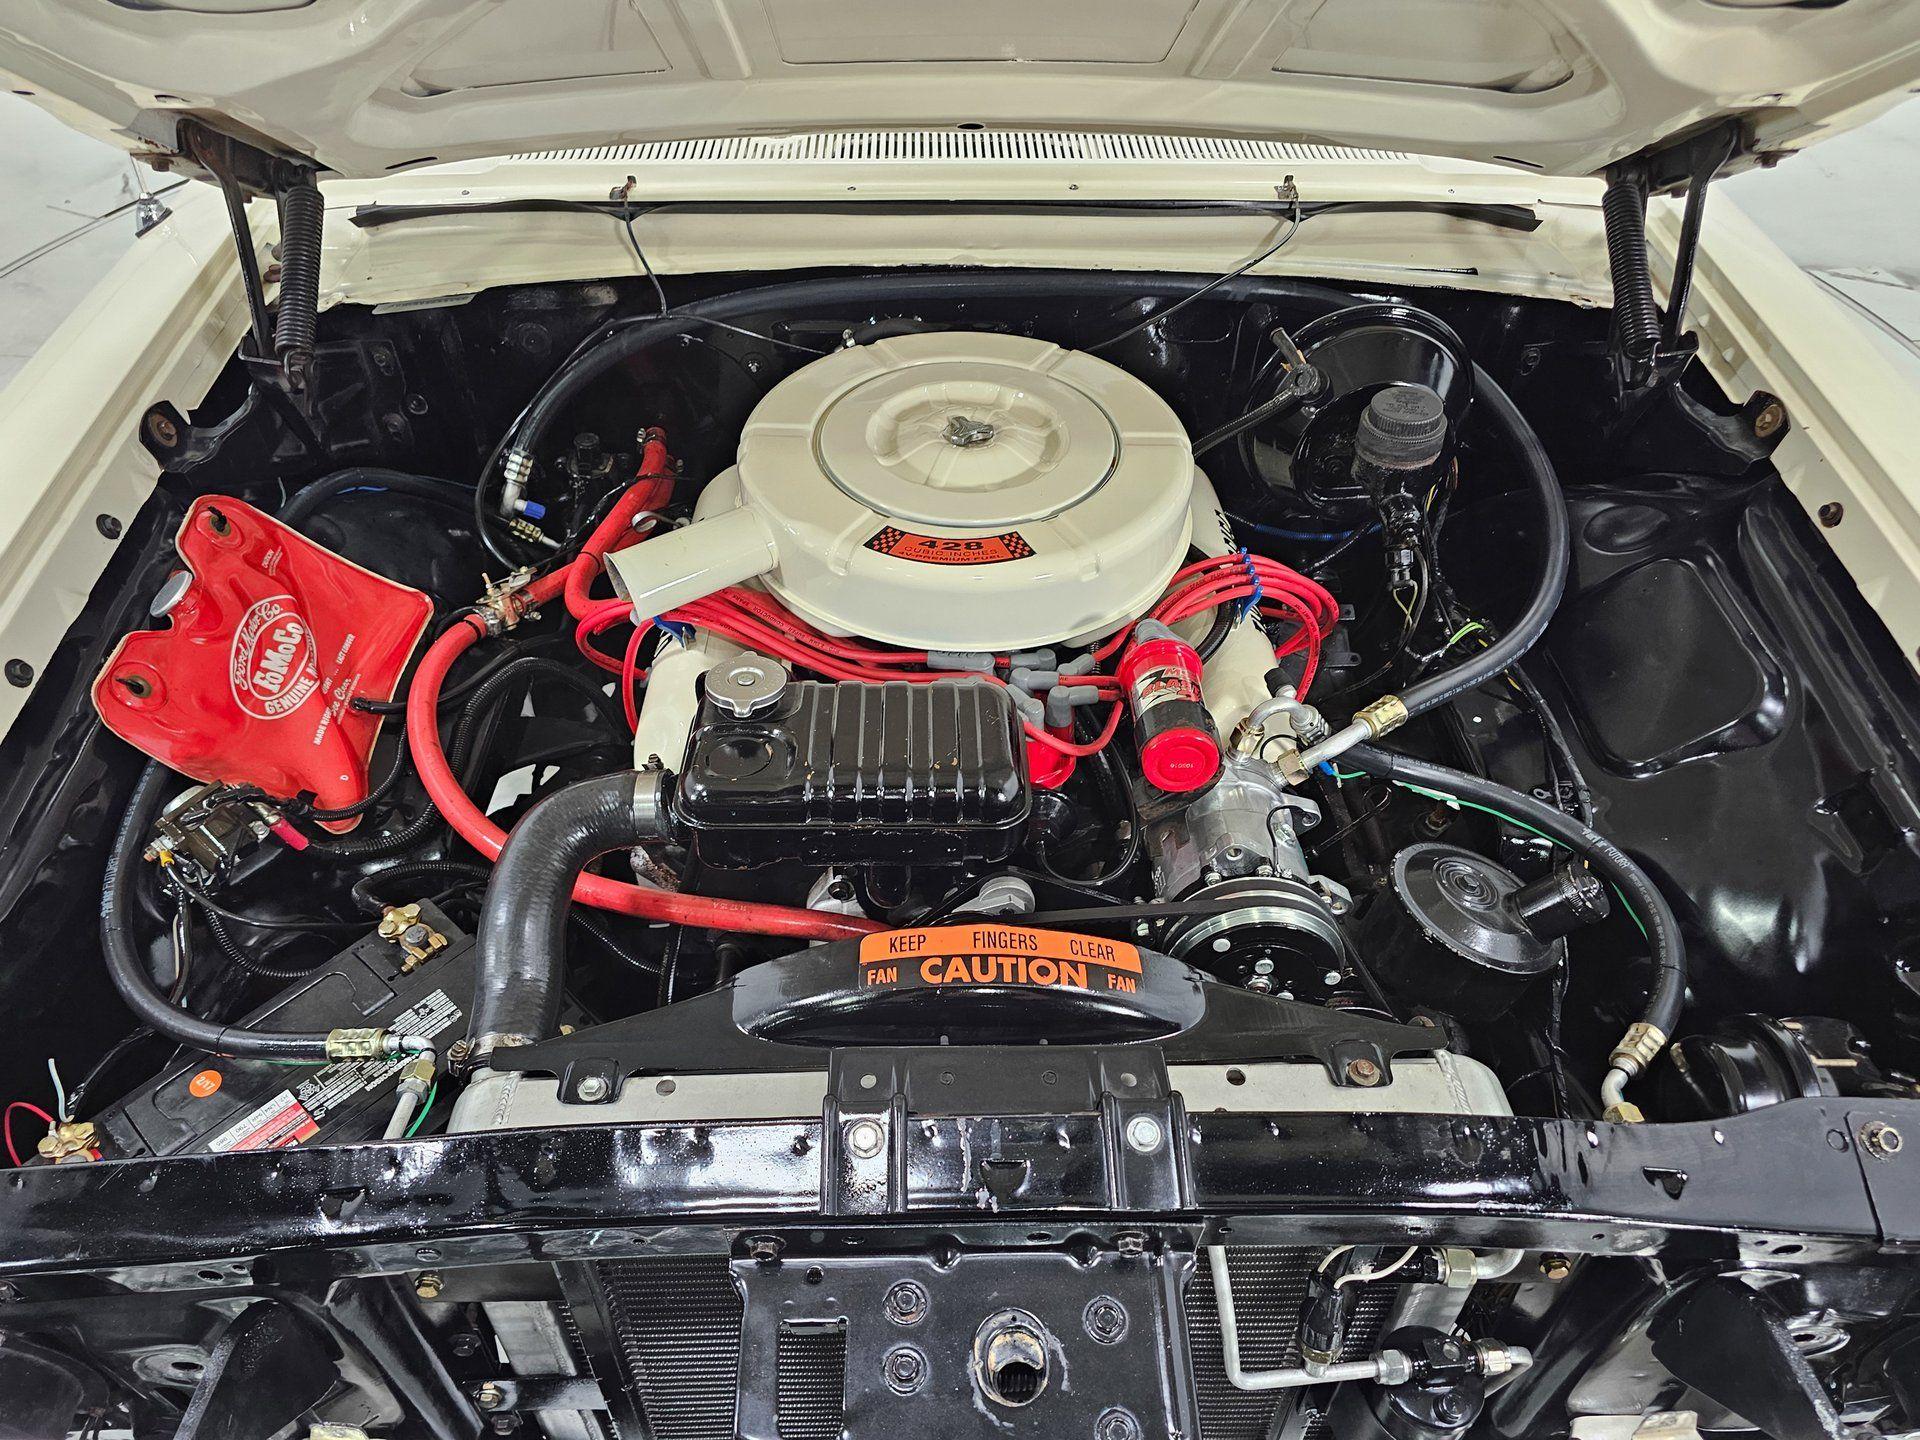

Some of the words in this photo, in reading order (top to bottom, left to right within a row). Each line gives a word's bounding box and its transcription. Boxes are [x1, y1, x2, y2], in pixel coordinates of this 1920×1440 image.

[904, 546, 943, 556] CUBIC
[949, 549, 998, 557] INCHES
[918, 540, 984, 551] 428
[252, 622, 304, 693] FoMoCo
[264, 676, 315, 715] GENUINE
[313, 725, 327, 746] MADE
[889, 934, 927, 953] KEEP
[973, 931, 1038, 951] FINGERS
[1070, 939, 1115, 962] CLEAR
[867, 966, 897, 986] FAN
[920, 957, 1088, 989] CAUTION
[1107, 973, 1136, 994] FAN
